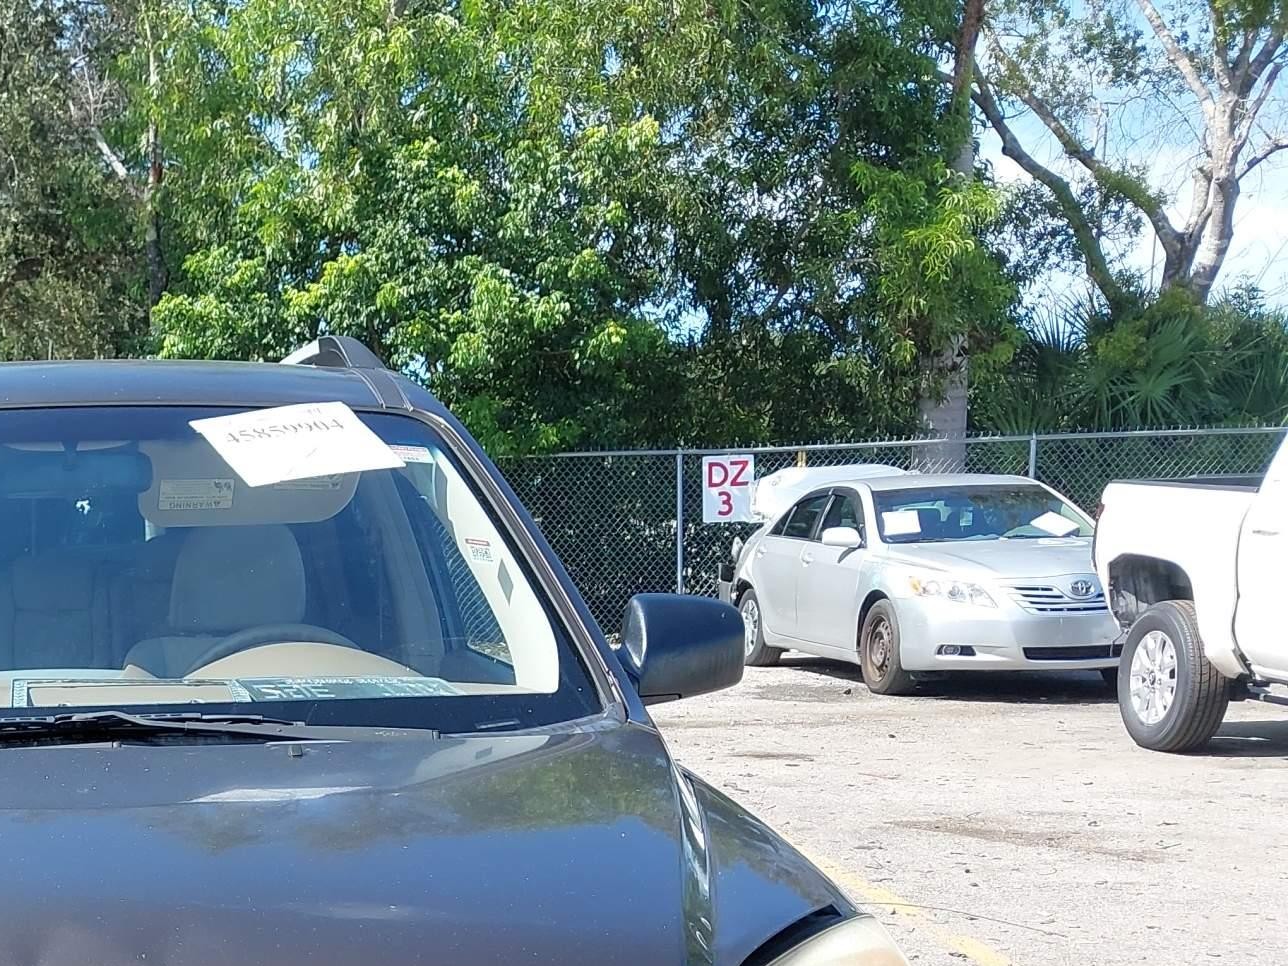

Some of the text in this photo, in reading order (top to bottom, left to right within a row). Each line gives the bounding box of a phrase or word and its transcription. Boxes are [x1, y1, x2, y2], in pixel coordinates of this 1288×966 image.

[227, 419, 344, 443] 45859904
[708, 460, 749, 488] DZ
[718, 491, 733, 516] 3
